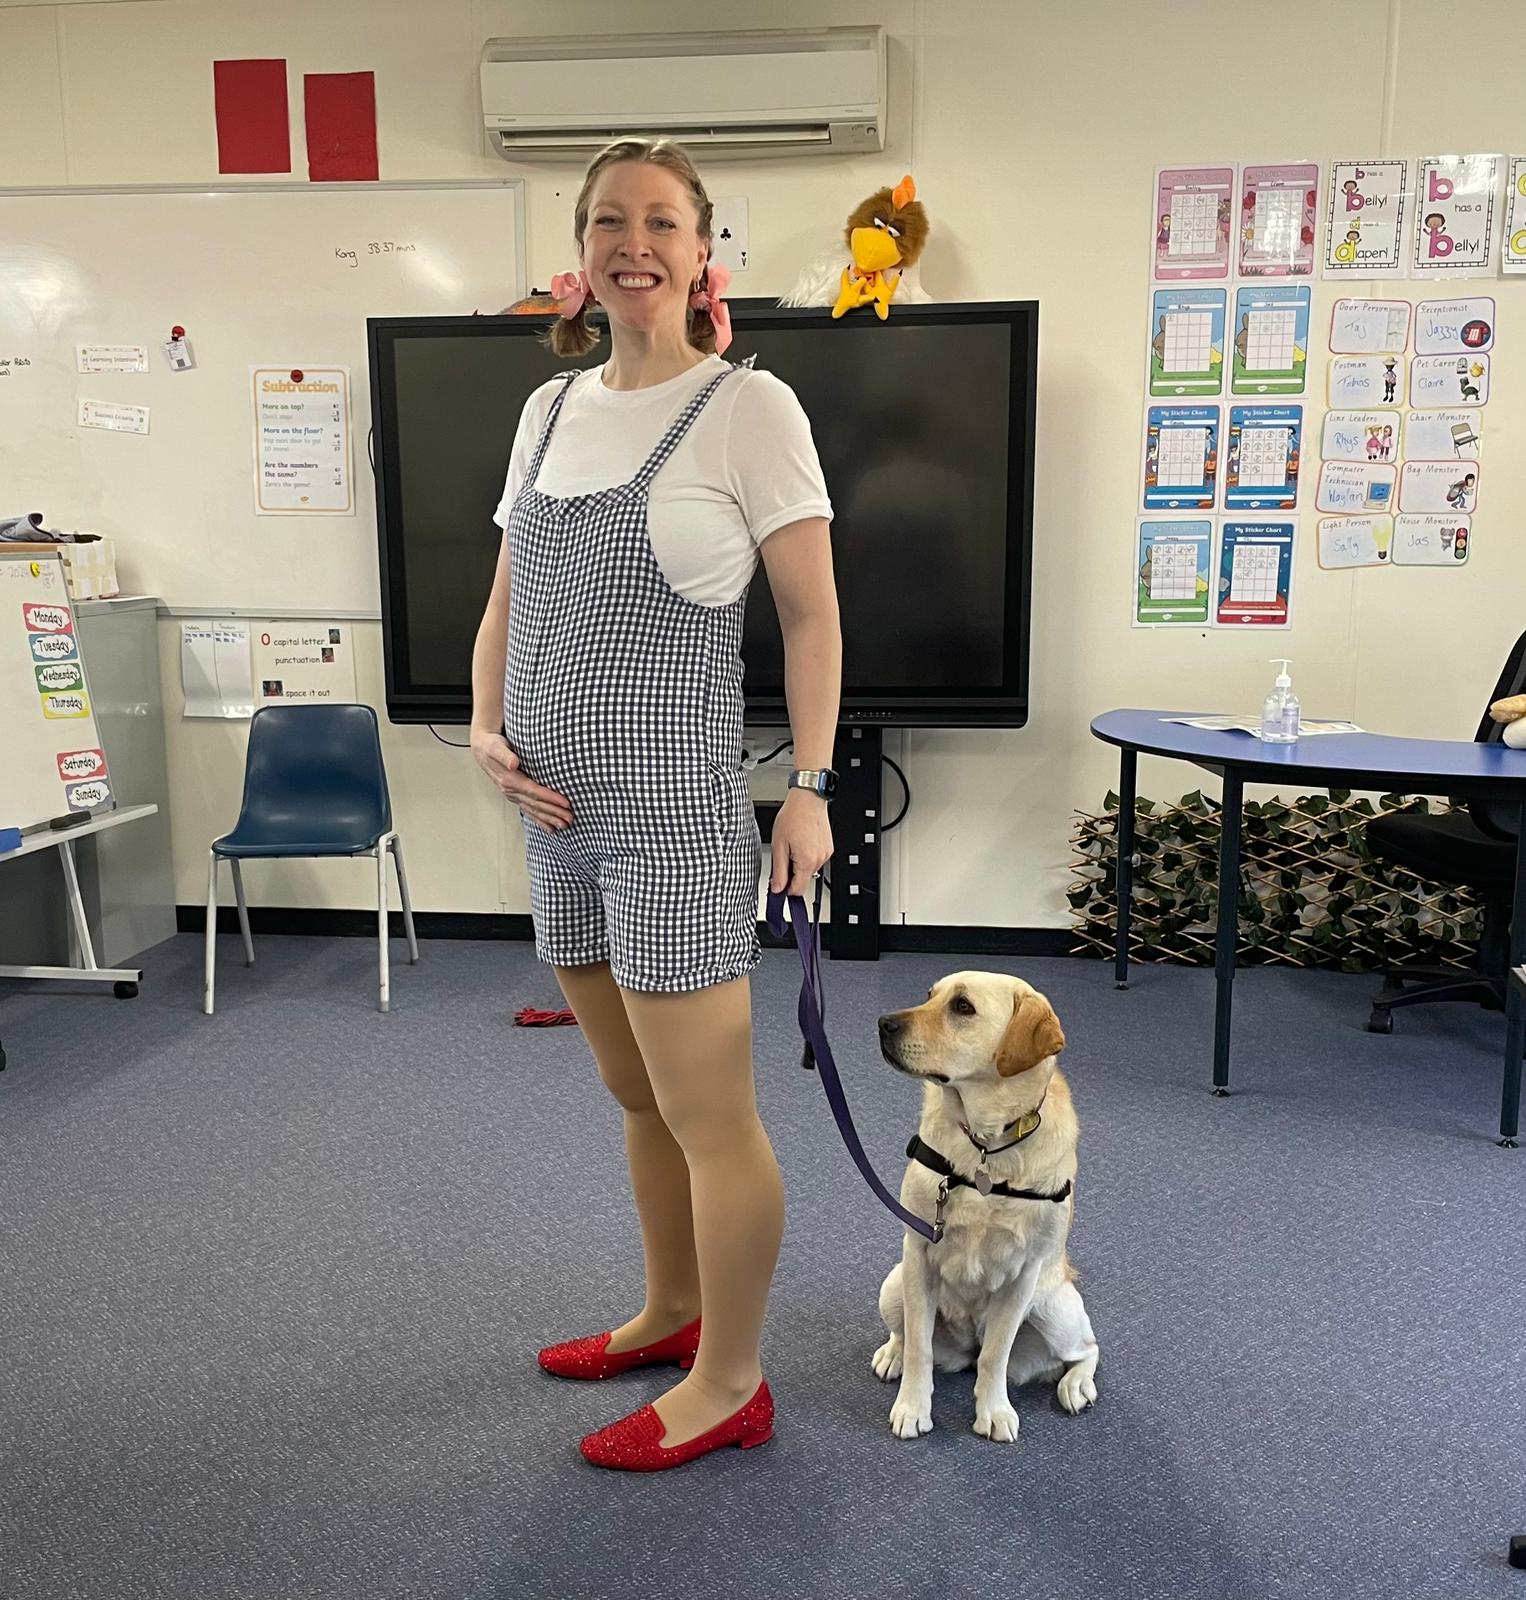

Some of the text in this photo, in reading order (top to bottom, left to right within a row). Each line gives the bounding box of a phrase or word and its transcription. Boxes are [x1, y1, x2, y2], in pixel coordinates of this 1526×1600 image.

[1355, 167, 1365, 180] b
[1428, 170, 1455, 202] b
[1346, 191, 1387, 212] belly!
[1454, 203, 1482, 213] has a
[396, 244, 416, 253] mins
[1428, 228, 1480, 258] belly!
[1339, 301, 1390, 311] Door Person
[1420, 304, 1468, 318] Receptionist
[1344, 318, 1367, 339] Taj
[1426, 319, 1459, 341] Jazzy
[1334, 360, 1367, 369] Postman
[1416, 359, 1431, 368] Pet
[262, 380, 339, 393] Subtraction
[1337, 375, 1370, 388] Tobias
[1418, 377, 1444, 389] Claire
[290, 403, 305, 412] top?
[1349, 413, 1377, 422] Leaders
[1409, 412, 1471, 421] Chair Monitor
[304, 427, 324, 436] floor?
[1334, 432, 1359, 453] Rhys
[290, 461, 319, 469] numbers
[1326, 463, 1365, 474] Computer
[1406, 465, 1460, 474] Bag Monitor
[1325, 475, 1364, 487] Technician
[1322, 518, 1372, 533] Light Person
[1399, 516, 1459, 525] Noise Monitor
[1408, 535, 1430, 547] Jas
[1333, 540, 1360, 558] Sally
[34, 610, 63, 627] Monday
[37, 640, 70, 653] Tuesday
[273, 637, 300, 647] capital
[275, 656, 321, 667] punctuation
[43, 670, 78, 682] Wednesday
[286, 689, 331, 701] space it out
[49, 697, 83, 710] Thursday
[64, 756, 96, 770] Saturday
[76, 787, 101, 801] Sunday
